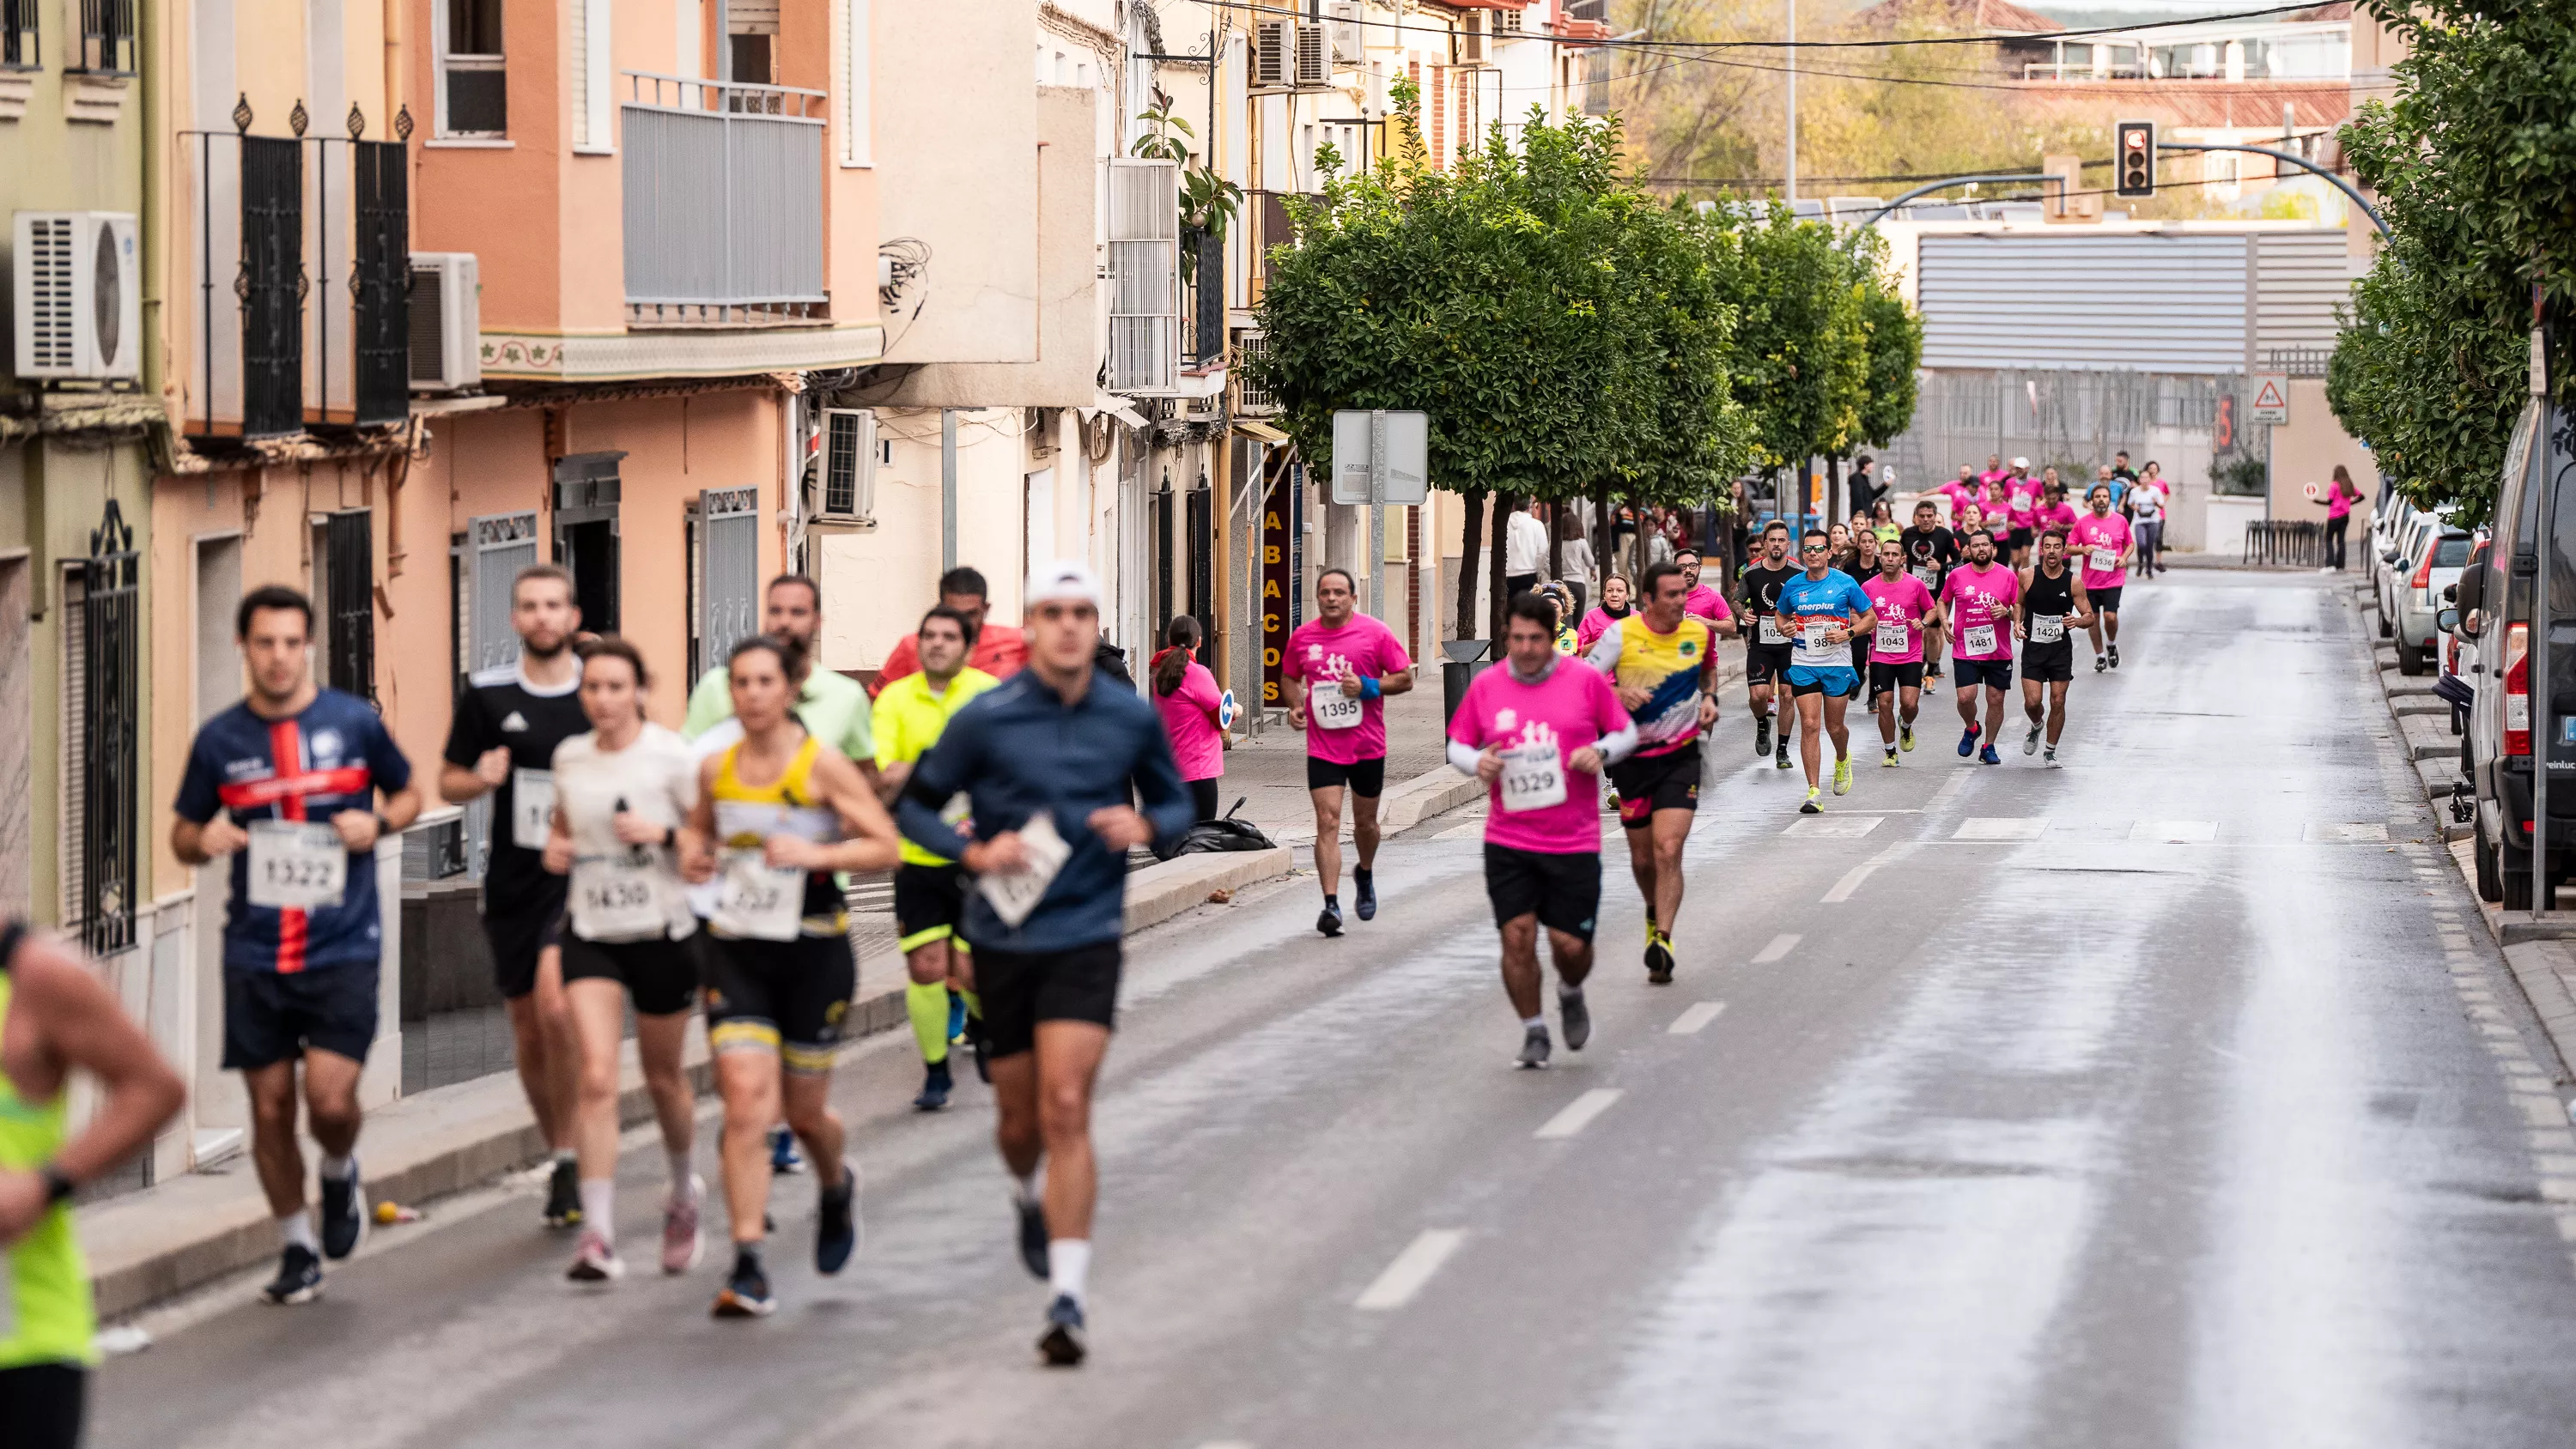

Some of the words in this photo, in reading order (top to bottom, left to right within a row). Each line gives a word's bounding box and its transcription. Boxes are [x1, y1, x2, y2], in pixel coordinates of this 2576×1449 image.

[1797, 603, 1835, 611] enerplus
[1803, 615, 1832, 623] Maratón
[1765, 628, 1782, 637] 105
[2037, 627, 2060, 637] 1420
[1814, 638, 1832, 647] 98
[1881, 637, 1905, 646] 1043
[1970, 637, 1992, 648] 1481
[1321, 700, 1358, 717] 1395
[1509, 773, 1554, 794] 1329
[266, 859, 334, 886] 1322
